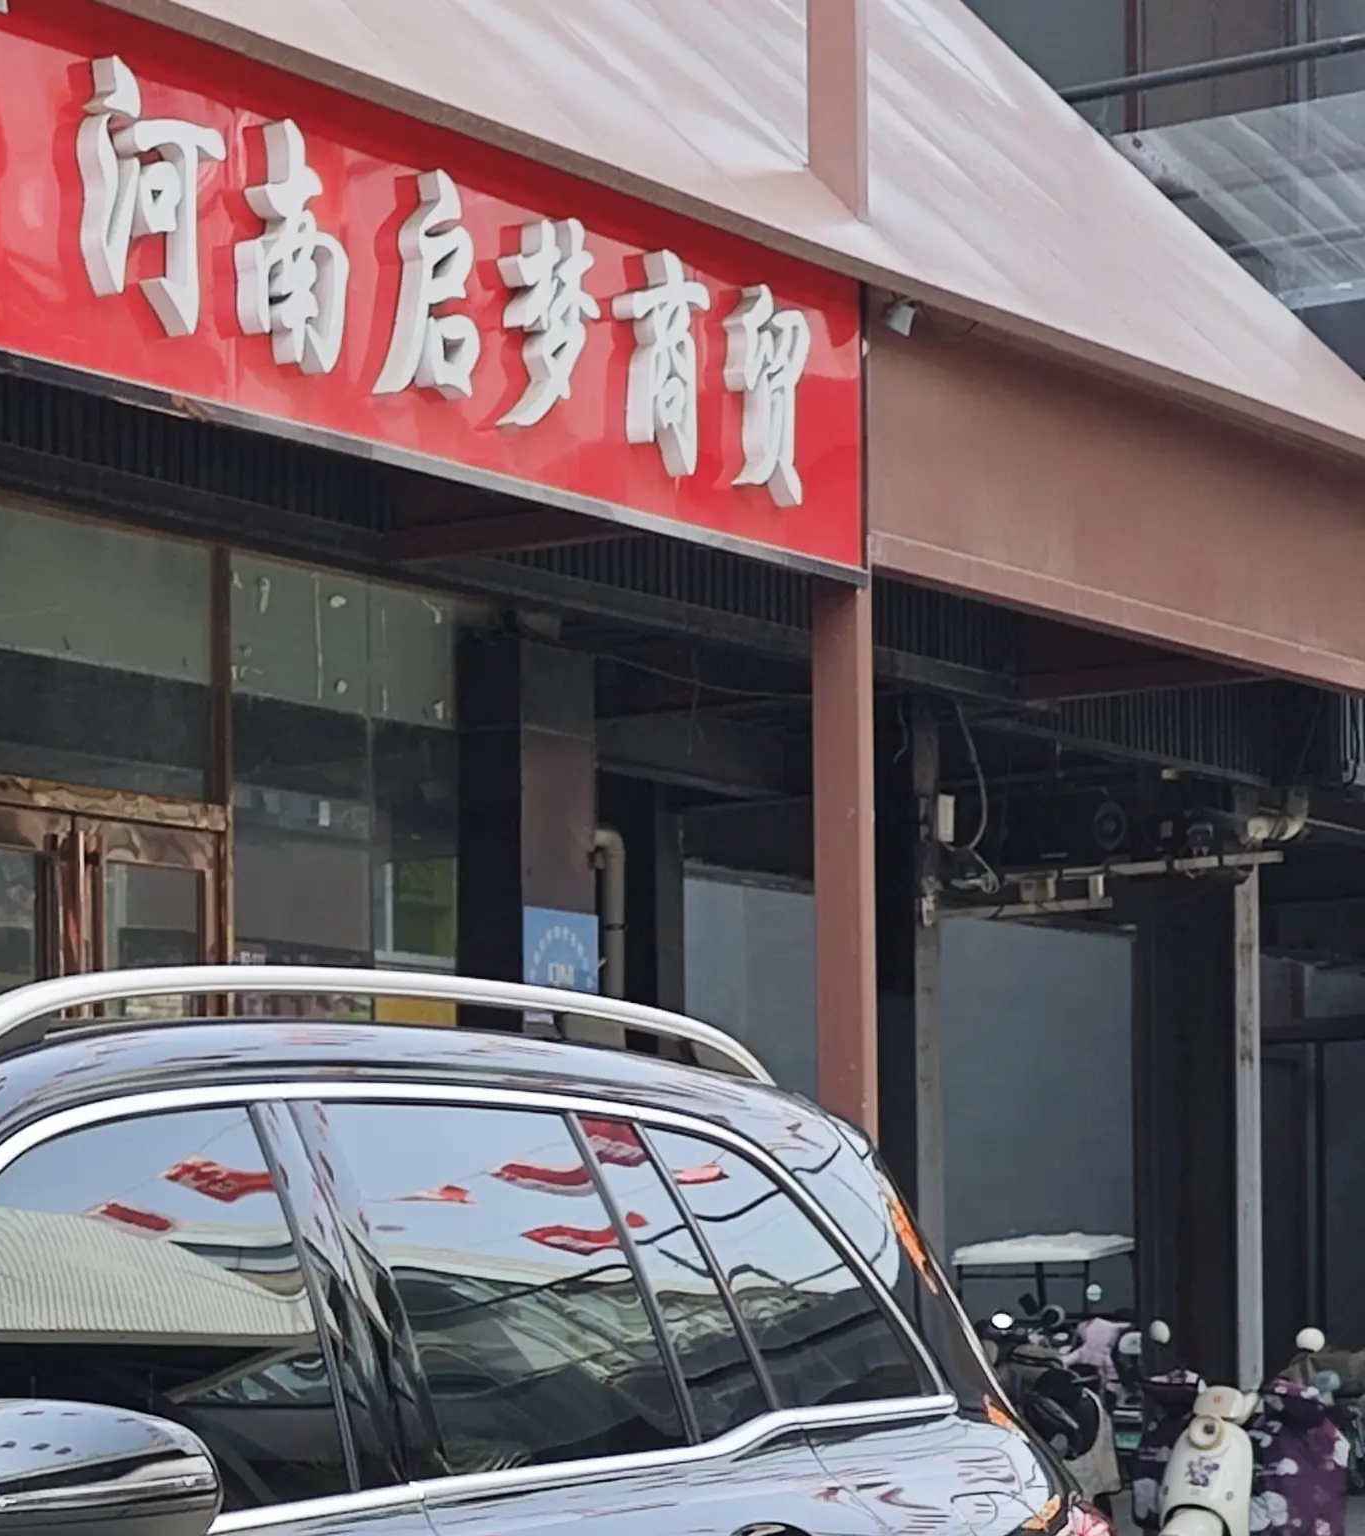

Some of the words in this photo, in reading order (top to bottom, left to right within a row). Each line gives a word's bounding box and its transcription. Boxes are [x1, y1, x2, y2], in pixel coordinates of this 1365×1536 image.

[77, 55, 810, 507] 河南启梦商贸
